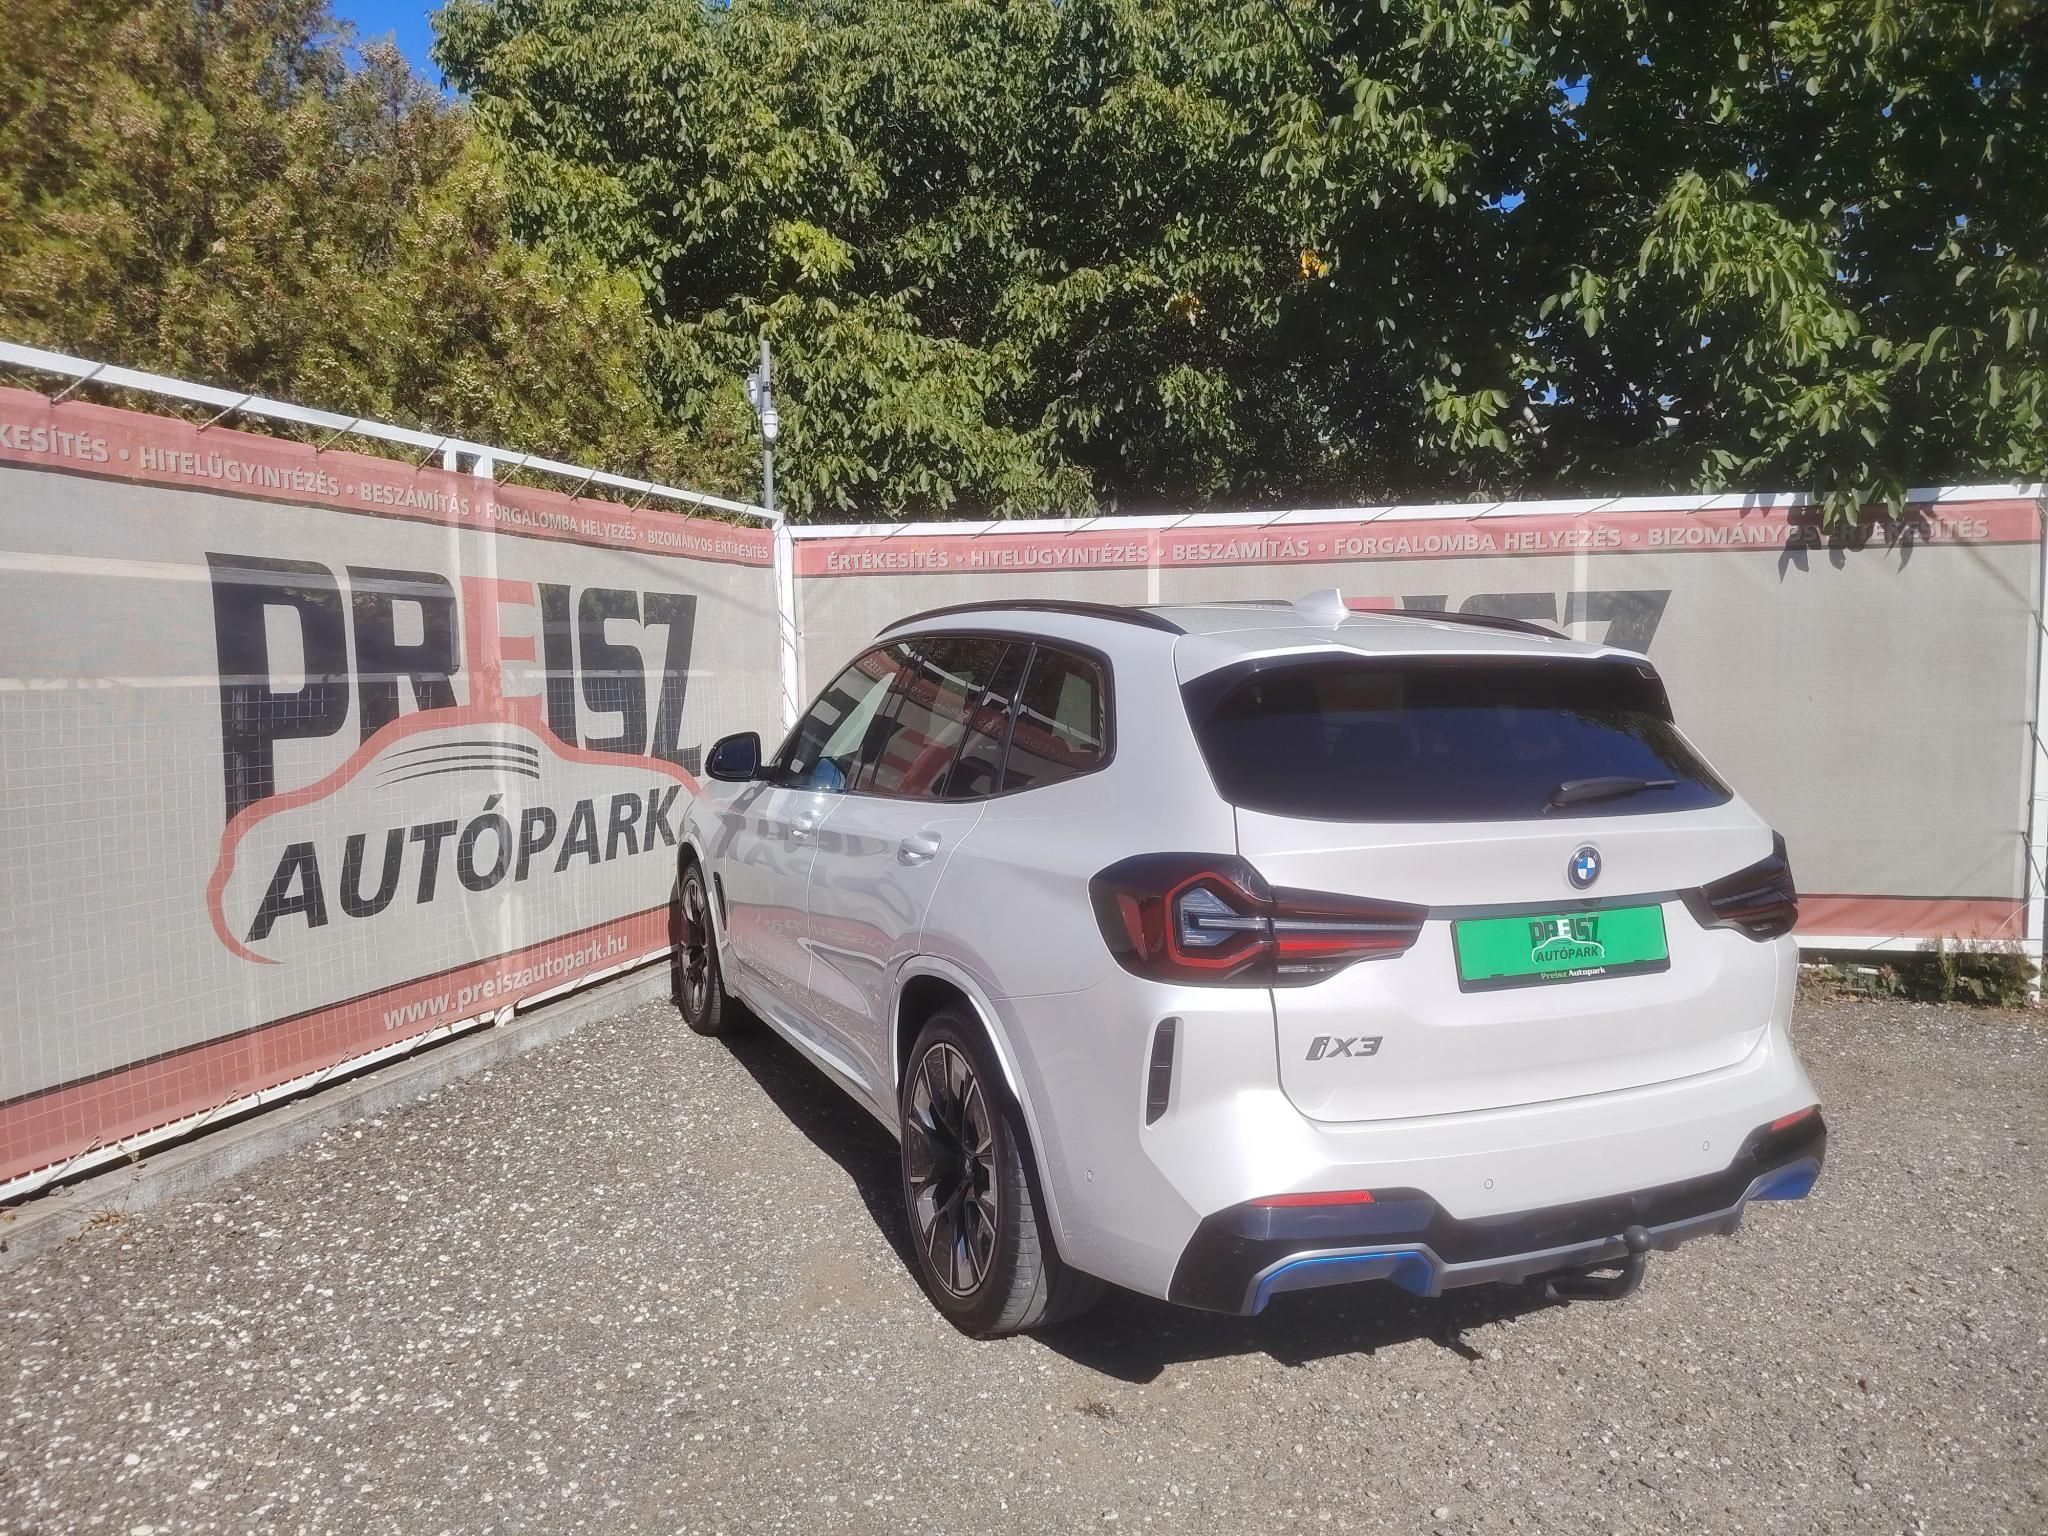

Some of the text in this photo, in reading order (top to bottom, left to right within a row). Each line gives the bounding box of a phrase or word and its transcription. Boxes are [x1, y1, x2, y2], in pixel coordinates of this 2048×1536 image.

[140, 446, 340, 497] HITELÜGYINTÉZÉS
[361, 482, 470, 516] BESZÁMÍTÁS
[486, 502, 578, 533] FORGALOMBA
[582, 519, 637, 541] HELYEZÉS
[648, 529, 712, 552] BIZOMÁNYOS
[827, 549, 949, 571] ÉRTÉKESÍTÉS
[970, 544, 1149, 567] HITELÜGYINTÉZÉS
[1172, 536, 1310, 561] BESZÁMÍTÁS
[1334, 533, 1497, 556] FORGALOMBA
[1504, 527, 1622, 550] HELYEZÉS
[1646, 521, 1818, 546] BIZOMÁNYOS
[205, 551, 700, 822] PREISZ
[245, 784, 682, 943] AUTÓPARK
[1528, 916, 1603, 950] PREISZ
[1536, 945, 1599, 962] AUTÓPARK
[383, 934, 629, 1031] www.preiszautopark.hu
[1568, 967, 1606, 978] Autopark
